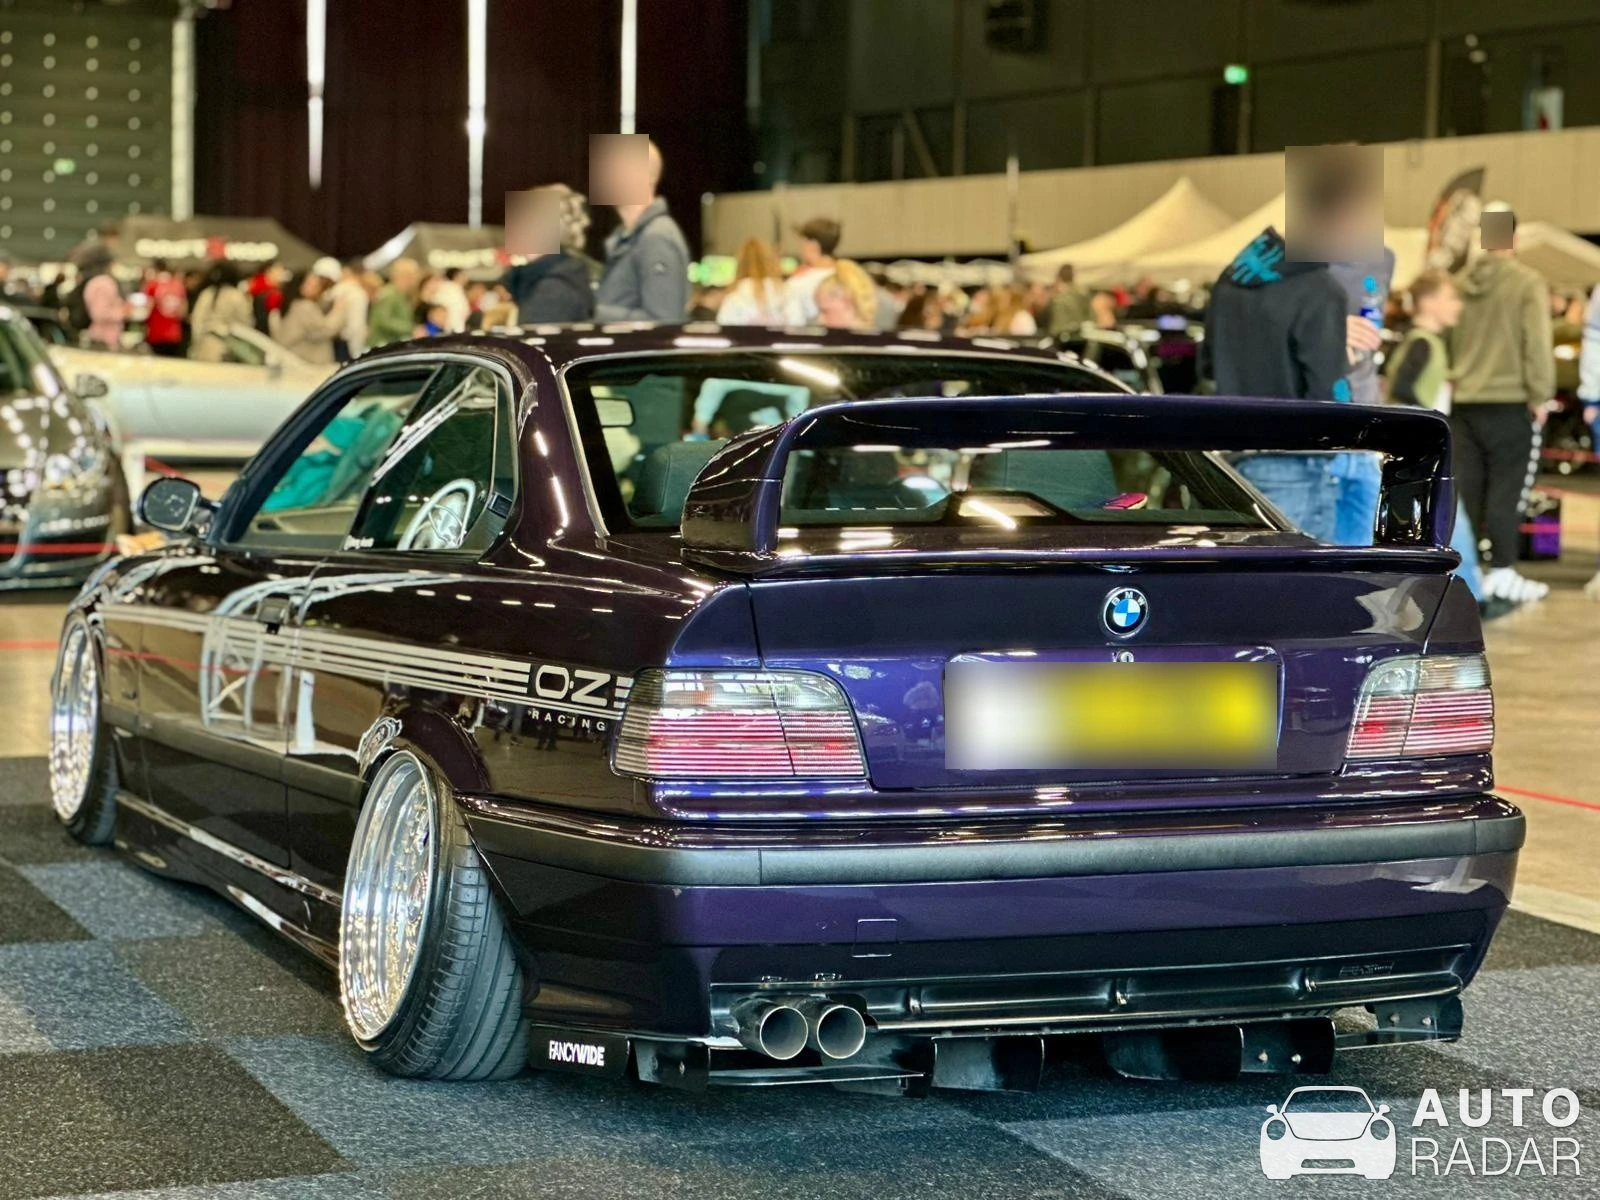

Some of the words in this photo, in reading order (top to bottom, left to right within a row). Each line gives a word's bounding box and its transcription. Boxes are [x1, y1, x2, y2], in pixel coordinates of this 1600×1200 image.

[1111, 591, 1146, 606] BMW
[531, 708, 606, 731] RACING
[548, 1039, 606, 1067] FANCYWIDE
